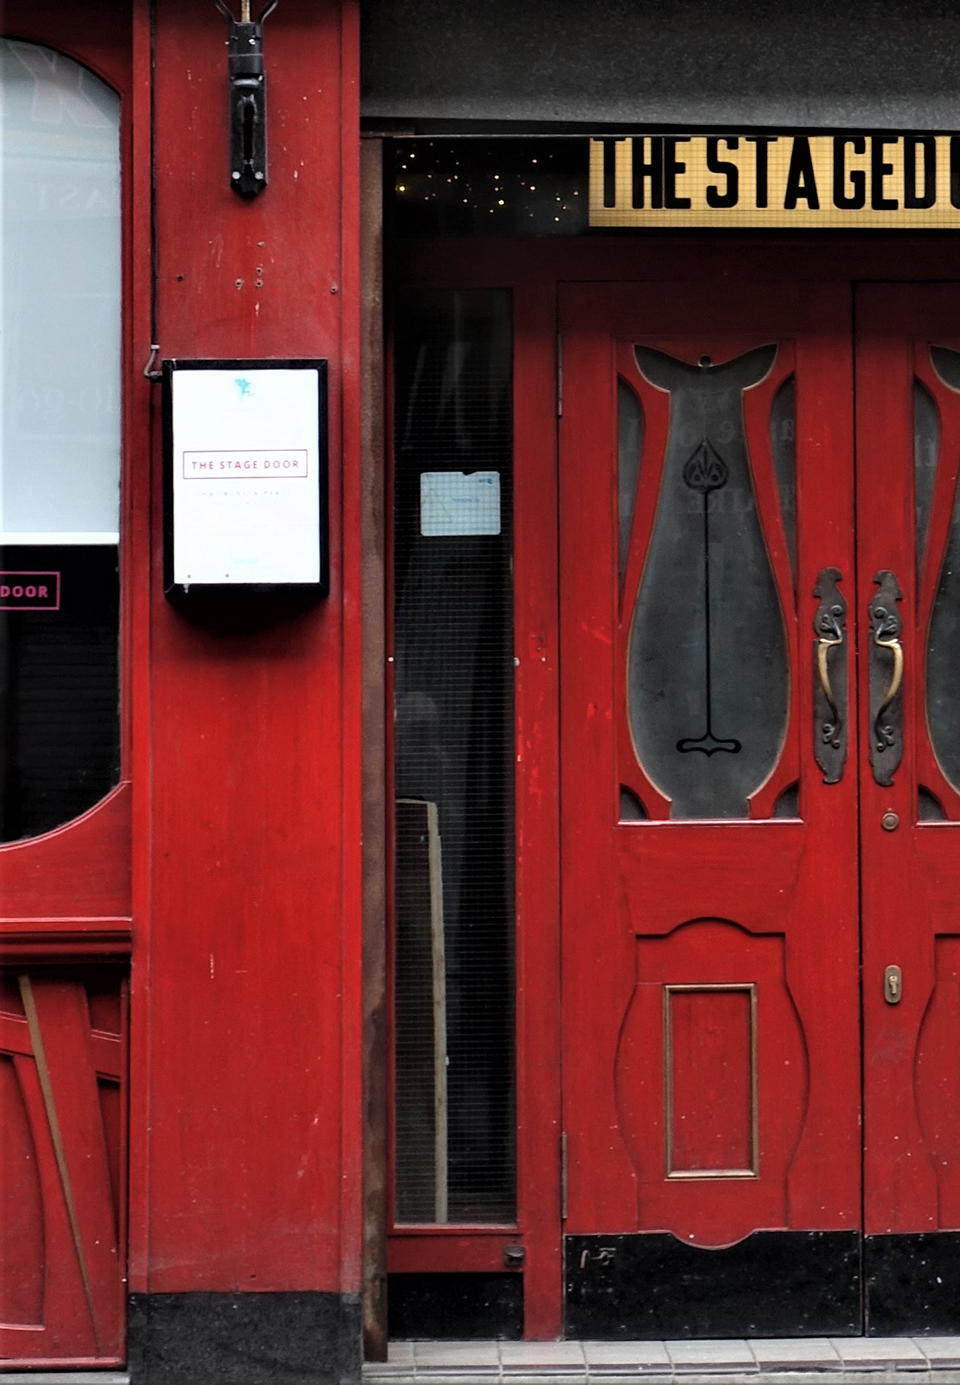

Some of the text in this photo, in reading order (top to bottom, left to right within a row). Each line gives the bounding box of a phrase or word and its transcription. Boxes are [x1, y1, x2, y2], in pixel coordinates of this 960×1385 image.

[191, 459, 299, 470] THE STAGE DOOR
[0, 585, 48, 598] DOOR
